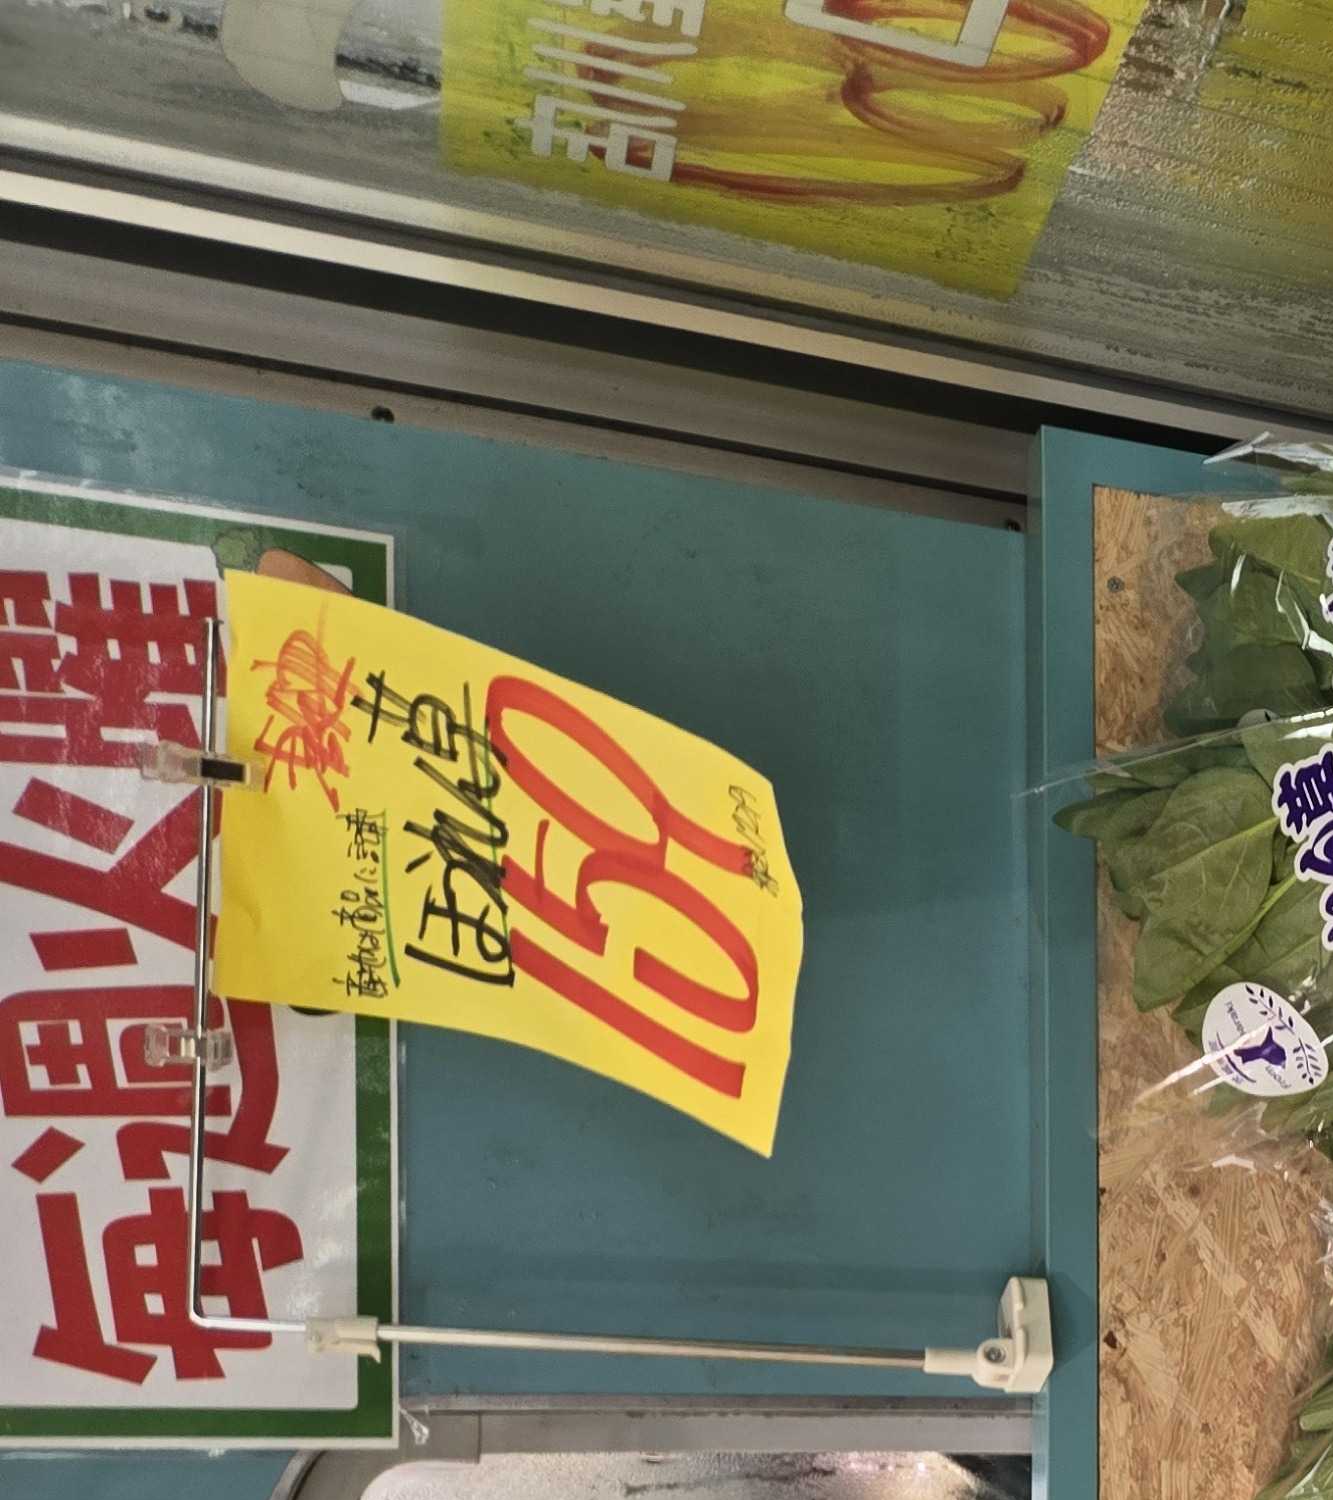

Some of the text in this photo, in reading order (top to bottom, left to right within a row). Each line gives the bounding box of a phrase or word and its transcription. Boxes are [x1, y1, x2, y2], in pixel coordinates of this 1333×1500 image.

[0, 570, 305, 1385] 毎週火曜
[486, 676, 760, 1100] 159
